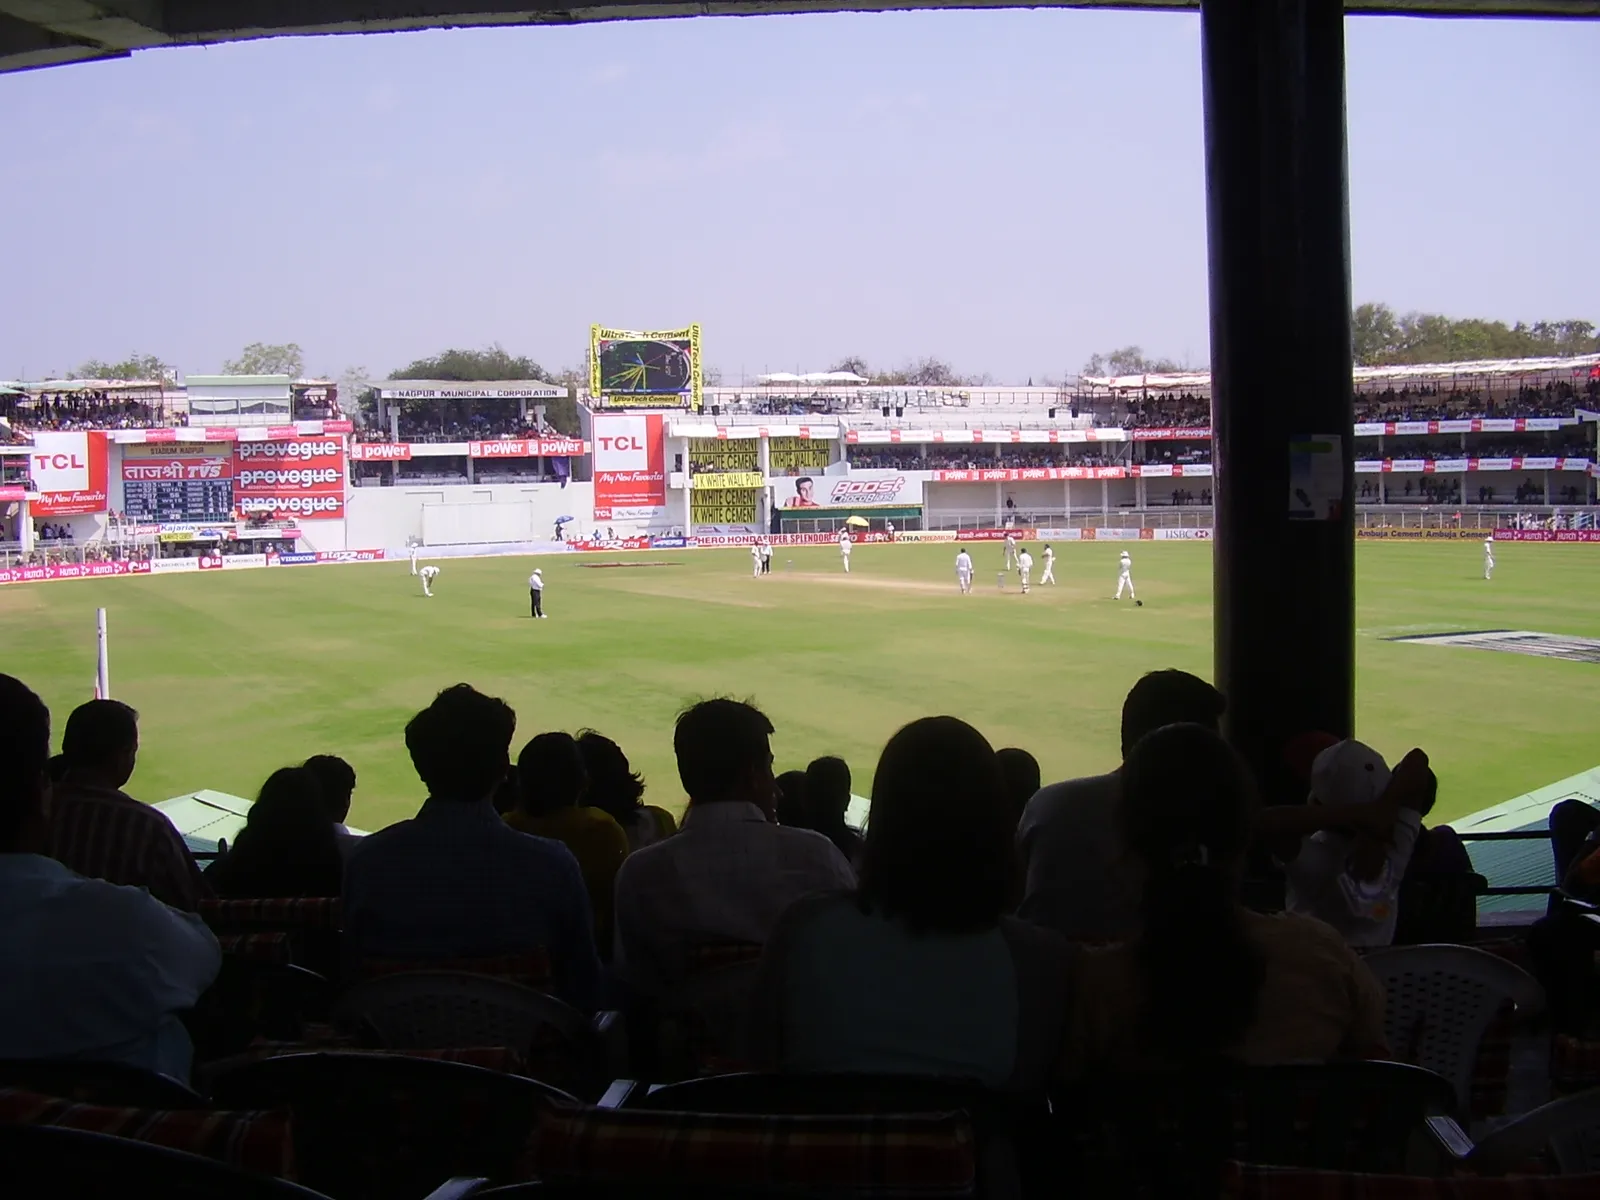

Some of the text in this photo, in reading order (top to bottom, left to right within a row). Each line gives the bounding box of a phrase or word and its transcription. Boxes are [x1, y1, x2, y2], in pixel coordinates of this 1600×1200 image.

[497, 389, 558, 397] CORPORATION
[240, 440, 338, 460] provogue
[598, 436, 643, 451] TCL
[727, 439, 757, 451] CEMENT
[34, 453, 84, 470] TCL
[727, 454, 757, 469] CEMENT
[124, 461, 184, 479] ताजश्री
[187, 465, 222, 478] TVS
[240, 467, 338, 488] provogue
[599, 472, 614, 484] My
[706, 474, 725, 487] WHITE
[727, 474, 744, 487] WALL
[37, 493, 53, 505] My
[700, 490, 722, 505] WHITE
[725, 490, 756, 505] CEMENT
[241, 496, 338, 516] provogue
[700, 508, 722, 523] WHITE
[725, 508, 756, 523] CEMENT
[160, 524, 193, 532] Kajaria
[1165, 530, 1192, 538] HSBC
[1358, 530, 1388, 538] Ambuja
[1426, 530, 1456, 539] Ambuja
[1460, 530, 1492, 538] Cement
[698, 536, 725, 545] HERO
[727, 535, 764, 544] HONDA
[790, 533, 830, 543] SPLENDOR
[281, 555, 316, 563] VIDEOCON
